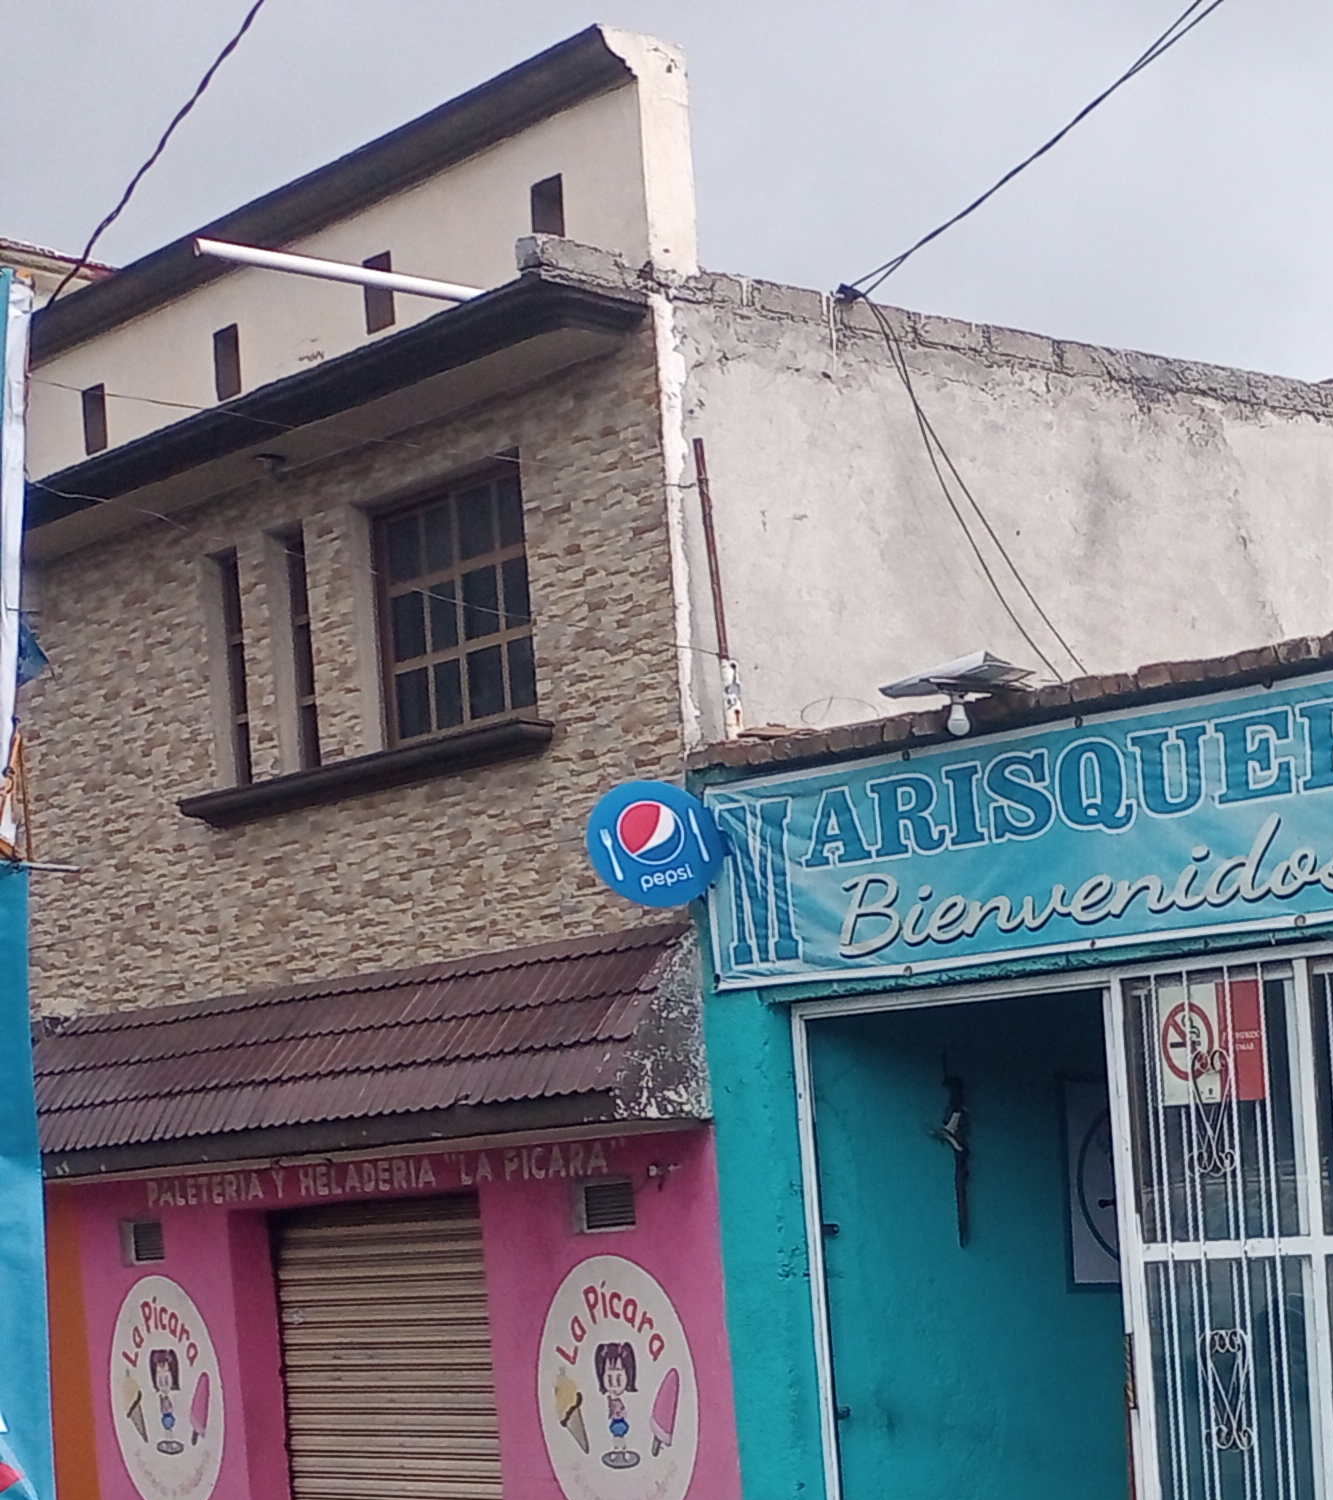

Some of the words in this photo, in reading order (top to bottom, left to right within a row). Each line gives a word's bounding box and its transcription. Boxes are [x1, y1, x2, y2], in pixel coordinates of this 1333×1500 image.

[640, 863, 694, 892] pepsi
[147, 1172, 264, 1208] PALETERIA
[271, 1173, 285, 1199] Y
[299, 1157, 436, 1198] HELADERIA
[122, 1326, 144, 1367] La
[556, 1315, 587, 1365] La
